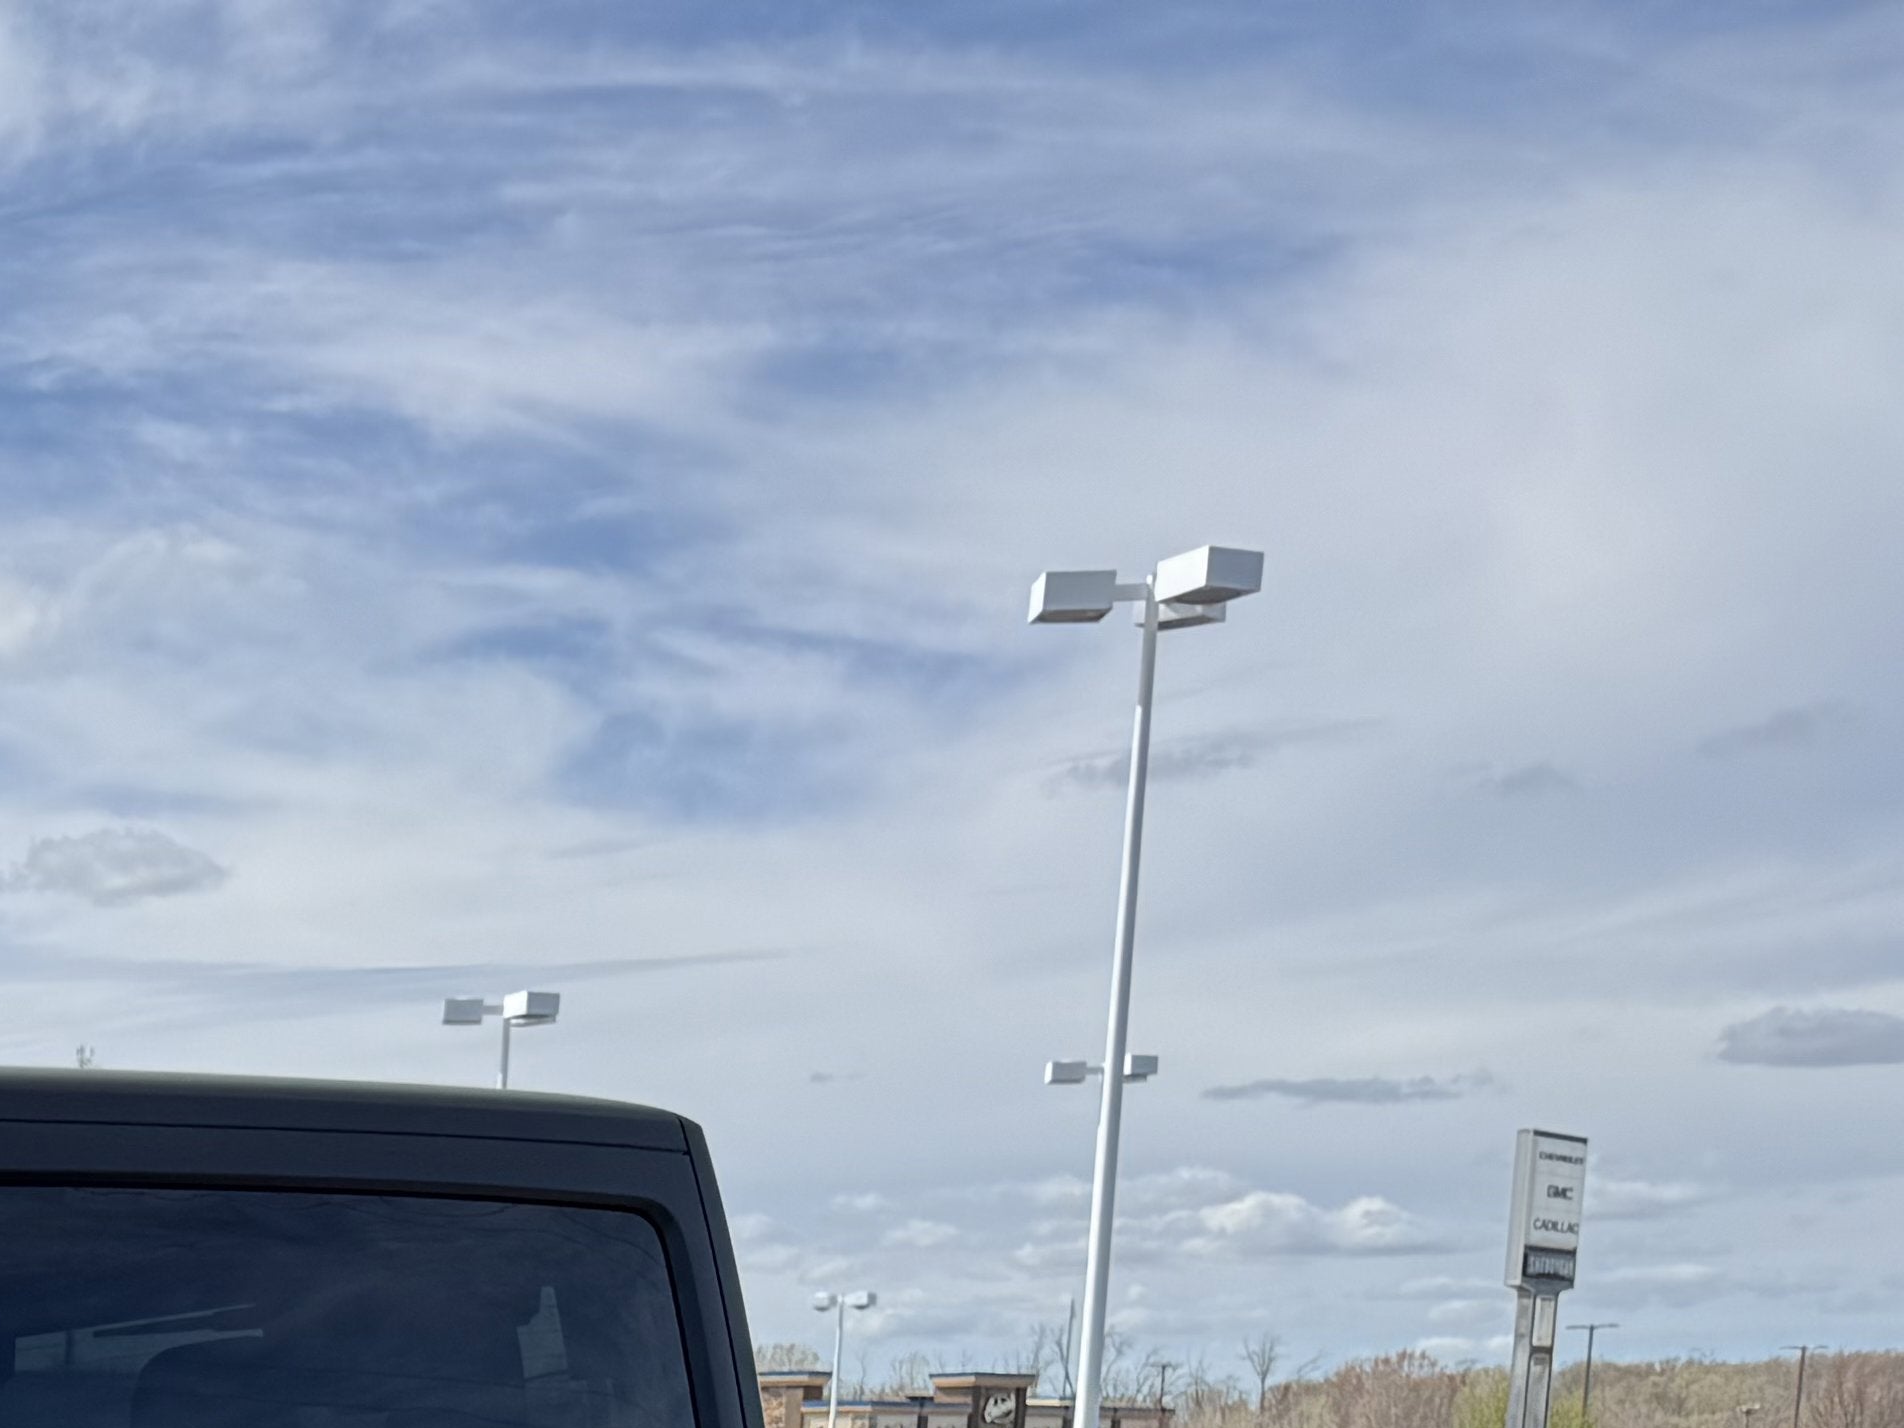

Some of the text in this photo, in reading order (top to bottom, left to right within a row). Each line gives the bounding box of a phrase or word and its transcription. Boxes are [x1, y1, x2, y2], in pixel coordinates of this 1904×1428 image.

[1538, 1150, 1585, 1166] CHEVROLET
[1547, 1184, 1574, 1200] GMC
[1532, 1217, 1580, 1235] CADILLAC
